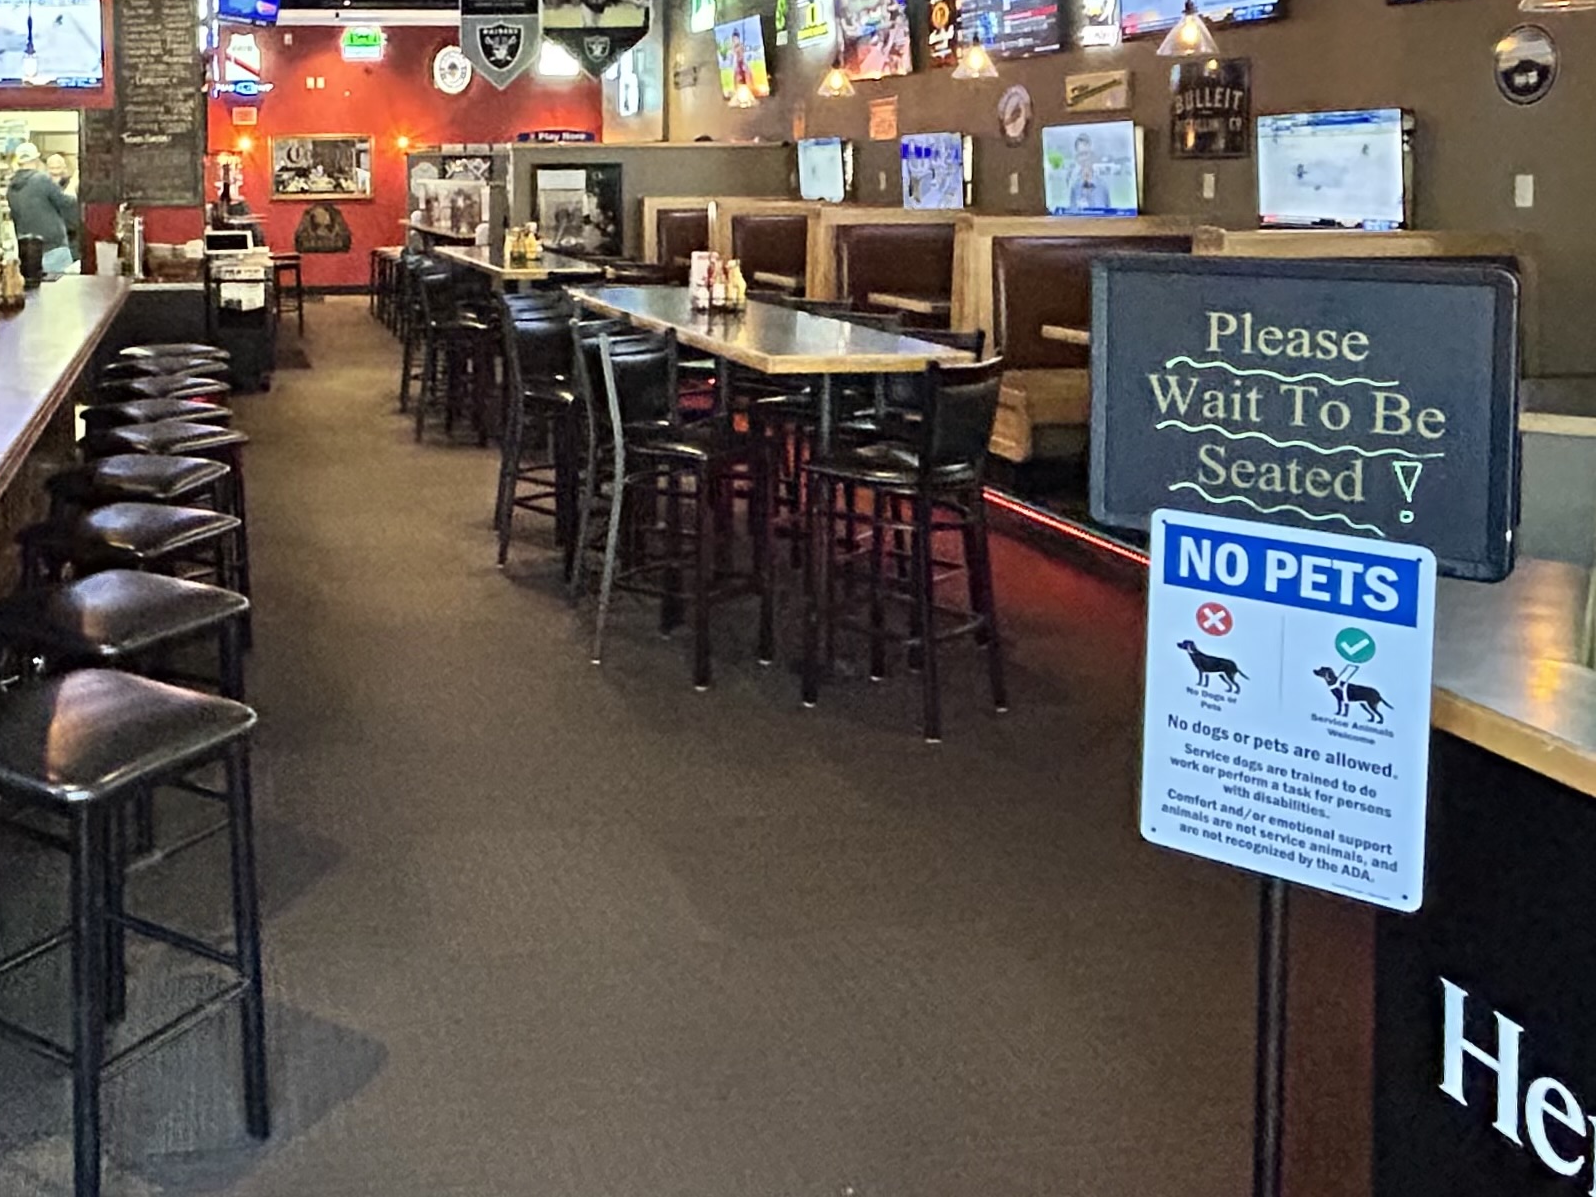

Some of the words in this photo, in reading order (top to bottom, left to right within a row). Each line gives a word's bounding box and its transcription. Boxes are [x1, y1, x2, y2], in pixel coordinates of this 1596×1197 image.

[1175, 86, 1244, 116] BULLEIT
[1205, 311, 1370, 363] Please
[1146, 372, 1262, 424] Wait
[1280, 383, 1351, 431] To
[1370, 391, 1446, 441] Be
[1197, 443, 1366, 503] Seated
[1179, 535, 1249, 587] NO
[1265, 548, 1400, 612] PETS
[1186, 686, 1199, 696] No
[1201, 690, 1225, 702] Dogs
[1200, 700, 1222, 712] Pets
[1167, 713, 1188, 731] No
[1192, 720, 1229, 741] dogs
[1233, 732, 1251, 745] or
[1253, 736, 1289, 754] pets
[1293, 745, 1321, 761] are
[1325, 751, 1399, 780] allowed.
[1311, 713, 1349, 728] Service
[1352, 722, 1394, 738] Animals
[1327, 728, 1376, 745] Welcome
[1170, 756, 1200, 772] work
[1202, 764, 1216, 775] or
[1218, 767, 1268, 788] perform
[1271, 781, 1280, 791] a
[1283, 782, 1312, 799] task
[1315, 789, 1334, 804] for
[1337, 797, 1392, 818] persons
[1184, 743, 1231, 764] Service
[1233, 755, 1263, 773] dogs
[1266, 764, 1288, 777] are
[1291, 768, 1339, 789] trained
[1342, 780, 1357, 793] to
[1359, 784, 1377, 798] do
[1167, 788, 1218, 810] Comfort
[1220, 803, 1266, 823] and/or
[1268, 816, 1335, 841] emotional
[1338, 834, 1393, 856] support
[1223, 784, 1250, 800] with
[1253, 791, 1330, 819] disabilities.
[1161, 803, 1209, 823] animals
[1212, 816, 1233, 829] are
[1235, 823, 1257, 837] not
[1259, 828, 1306, 848] service
[1309, 842, 1367, 866] animals,
[1371, 858, 1398, 873] and
[1179, 823, 1199, 836] are
[1202, 828, 1223, 843] not
[1225, 835, 1295, 861] recognized
[1298, 852, 1313, 869] by
[1316, 857, 1339, 873] the
[1341, 864, 1375, 883] ADA.
[1438, 976, 1596, 1197] He
